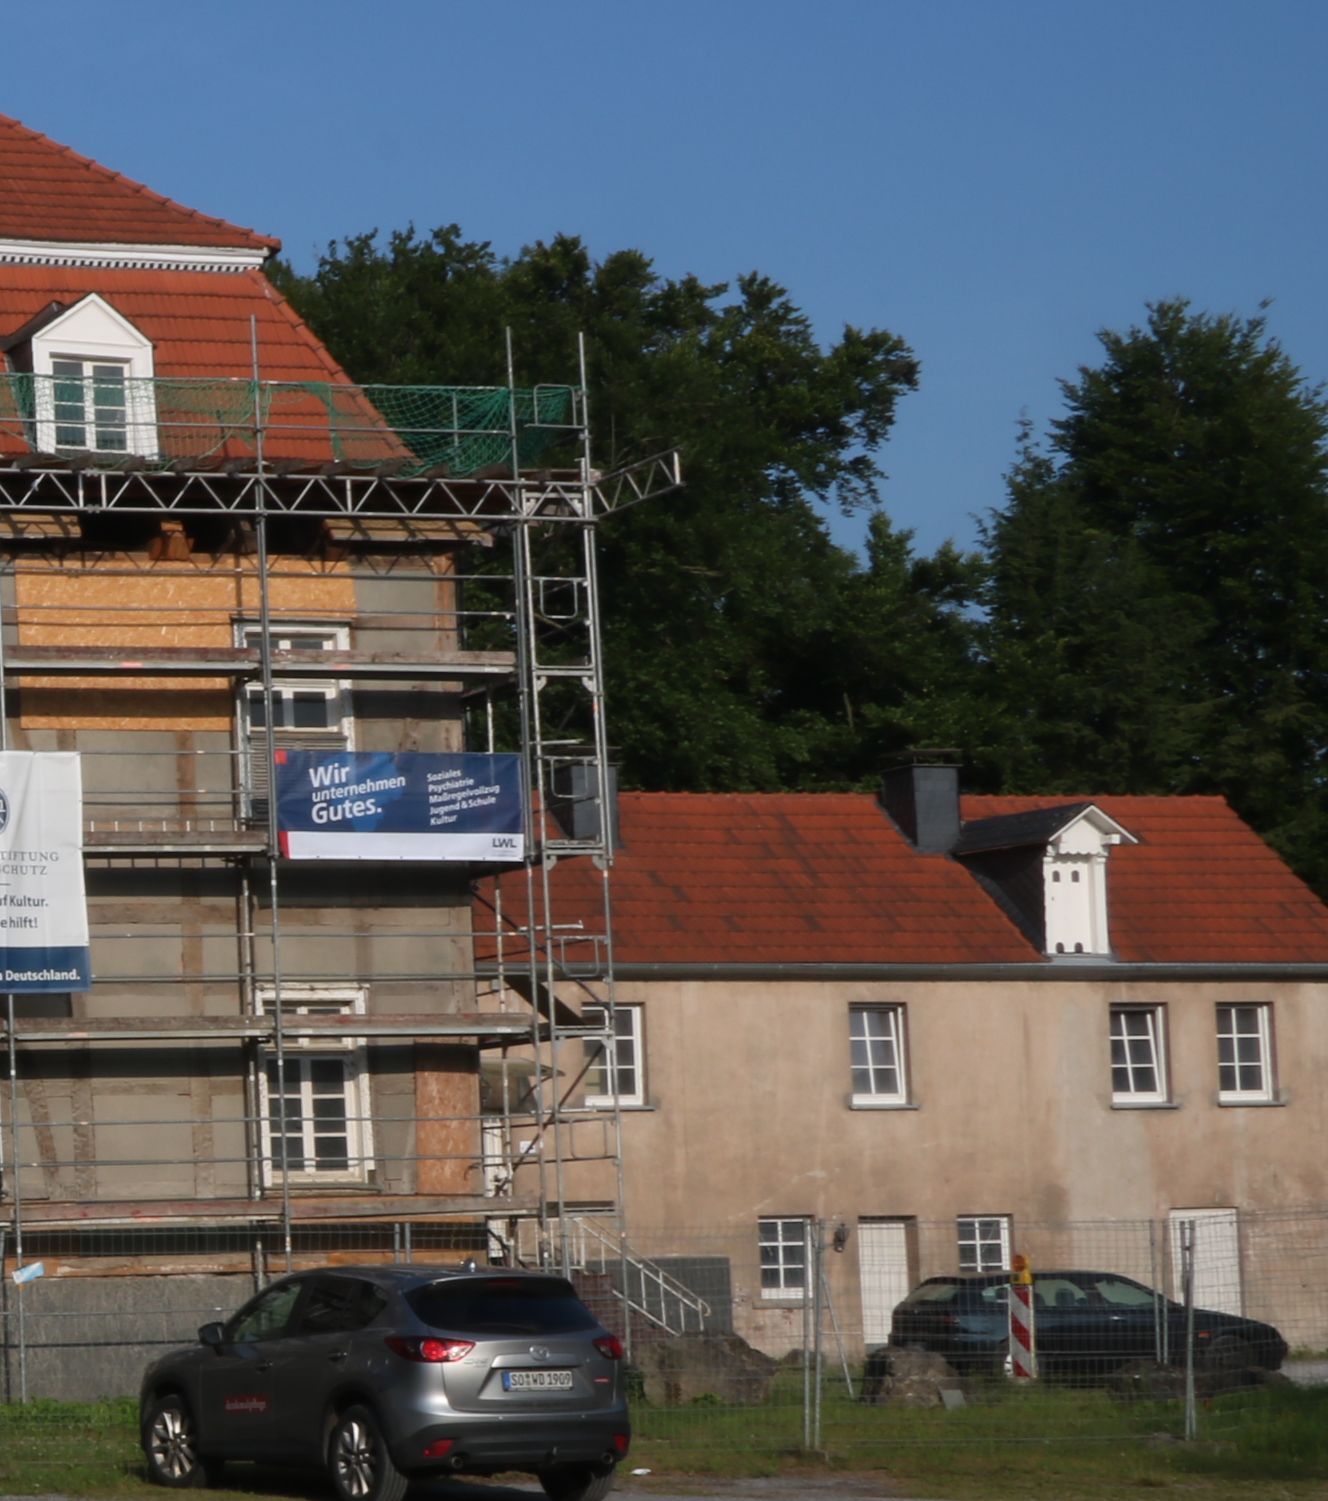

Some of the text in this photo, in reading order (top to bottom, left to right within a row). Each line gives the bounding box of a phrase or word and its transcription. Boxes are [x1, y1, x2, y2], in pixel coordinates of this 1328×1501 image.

[308, 762, 350, 788] Wir
[427, 769, 462, 782] Soziales
[312, 776, 406, 803] unternehmen
[428, 777, 475, 793] Psychiatrie
[429, 784, 501, 804] Maßregelvollzug
[311, 798, 383, 824] Gutes.
[429, 795, 497, 816] Jugend & Schule
[430, 814, 458, 826] Kultur
[492, 838, 517, 849] LWL
[9, 895, 49, 907] Kultur.
[9, 916, 38, 928] hilft!
[5, 968, 81, 981] Deutschland.
